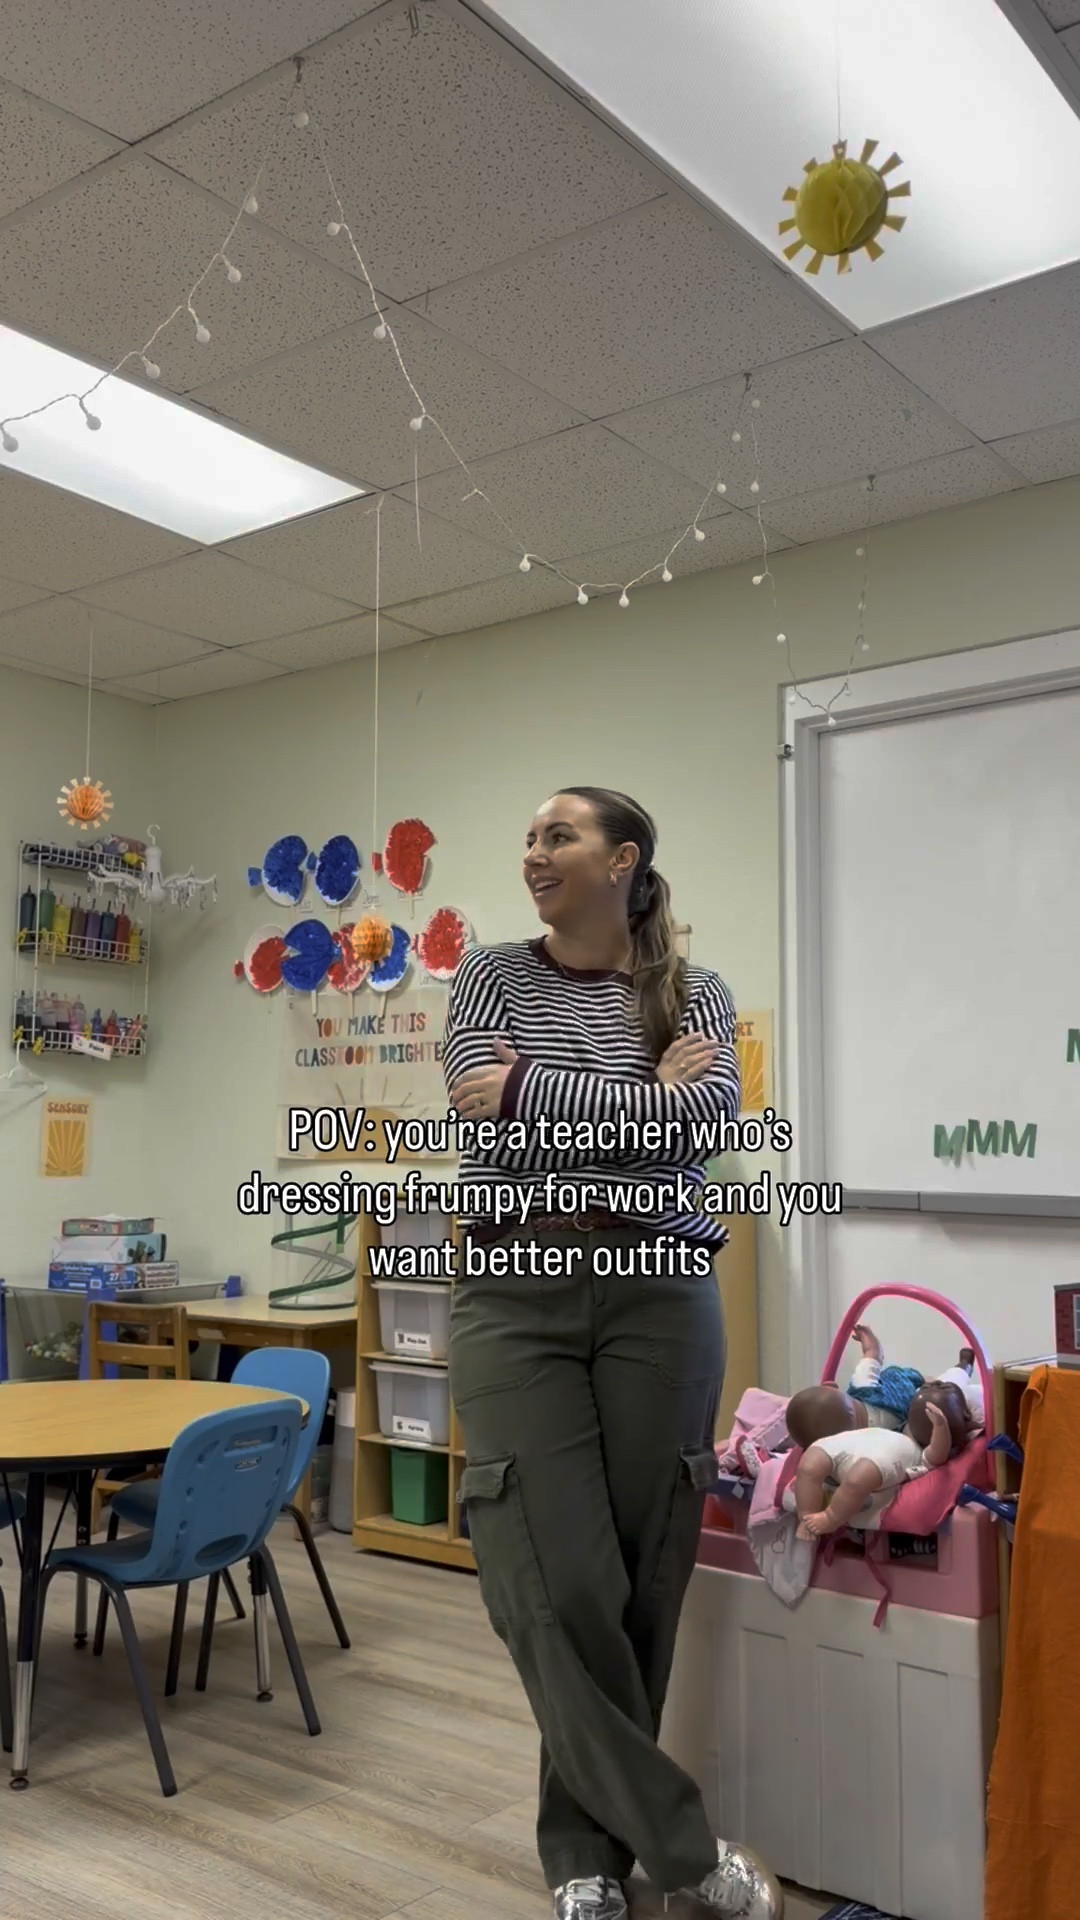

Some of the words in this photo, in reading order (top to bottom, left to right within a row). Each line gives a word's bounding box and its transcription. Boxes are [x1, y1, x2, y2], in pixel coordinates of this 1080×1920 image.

[316, 1017, 342, 1038] YOU
[348, 1014, 385, 1036] MAKE
[391, 1012, 427, 1033] THIS
[295, 1044, 374, 1067] CLASSROOM
[380, 1040, 446, 1063] BRIGHTE
